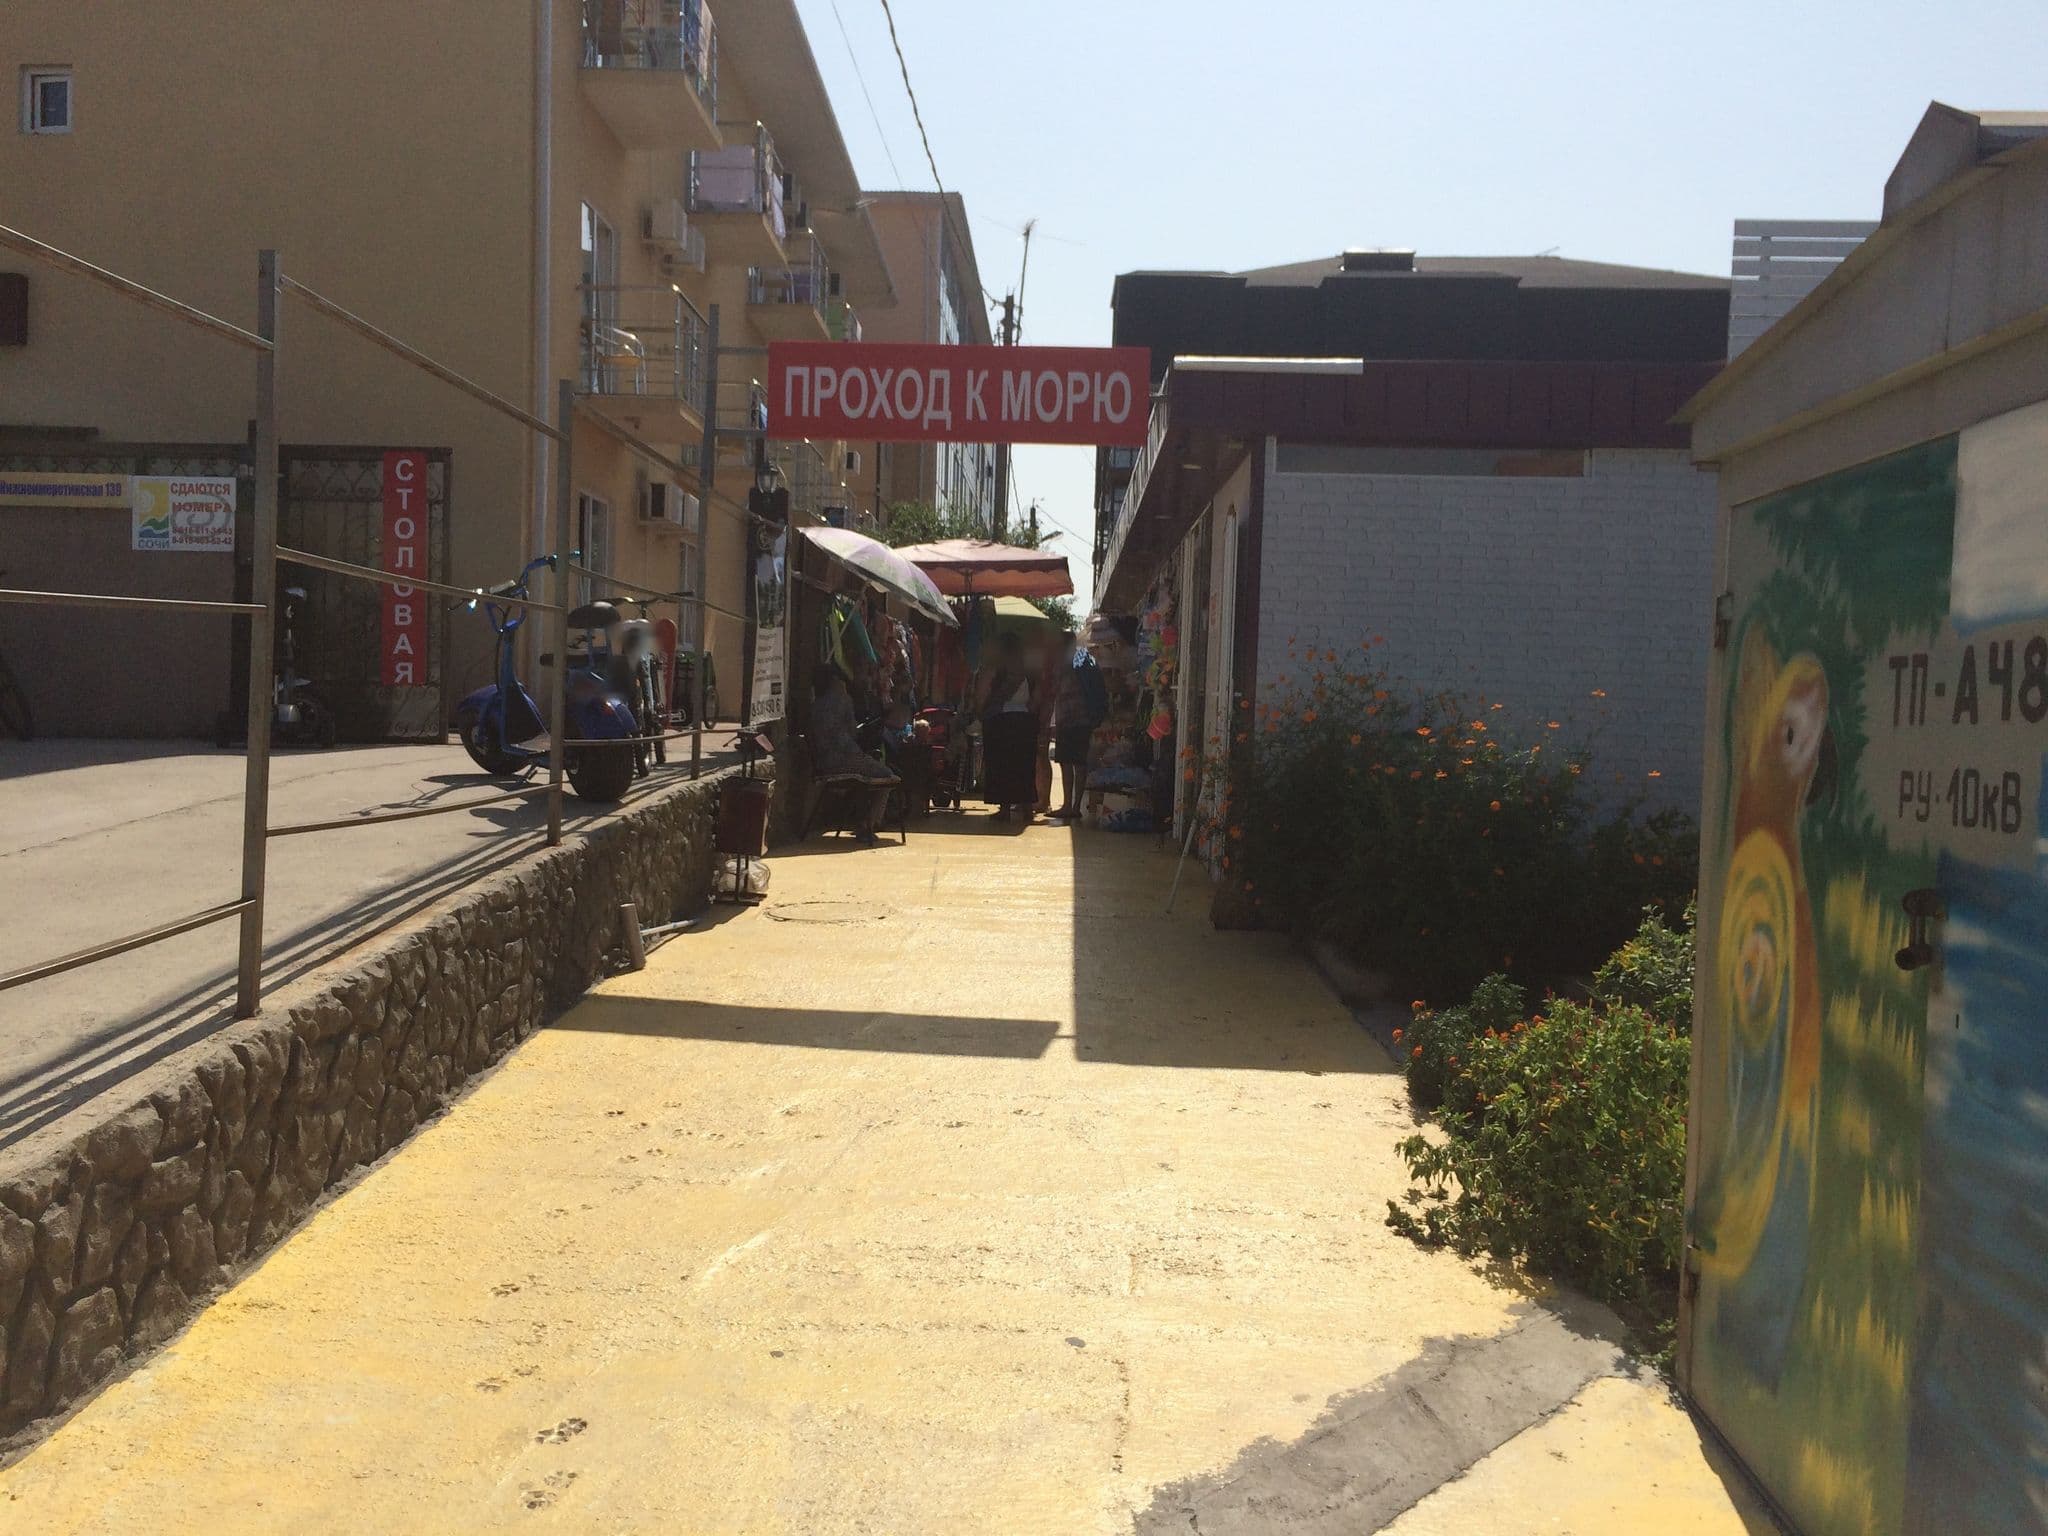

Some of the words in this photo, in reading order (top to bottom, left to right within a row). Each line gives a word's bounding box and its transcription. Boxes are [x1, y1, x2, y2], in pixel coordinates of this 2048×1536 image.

[784, 366, 951, 431] ПРОХОД
[966, 370, 988, 421] К
[1001, 370, 1132, 424] МОРЮ
[170, 483, 230, 496] СДАЮТСЯ
[172, 502, 232, 512] НОМЕРА
[138, 539, 170, 549] СОЧИ
[393, 459, 415, 684] СТОЛОВАЯ
